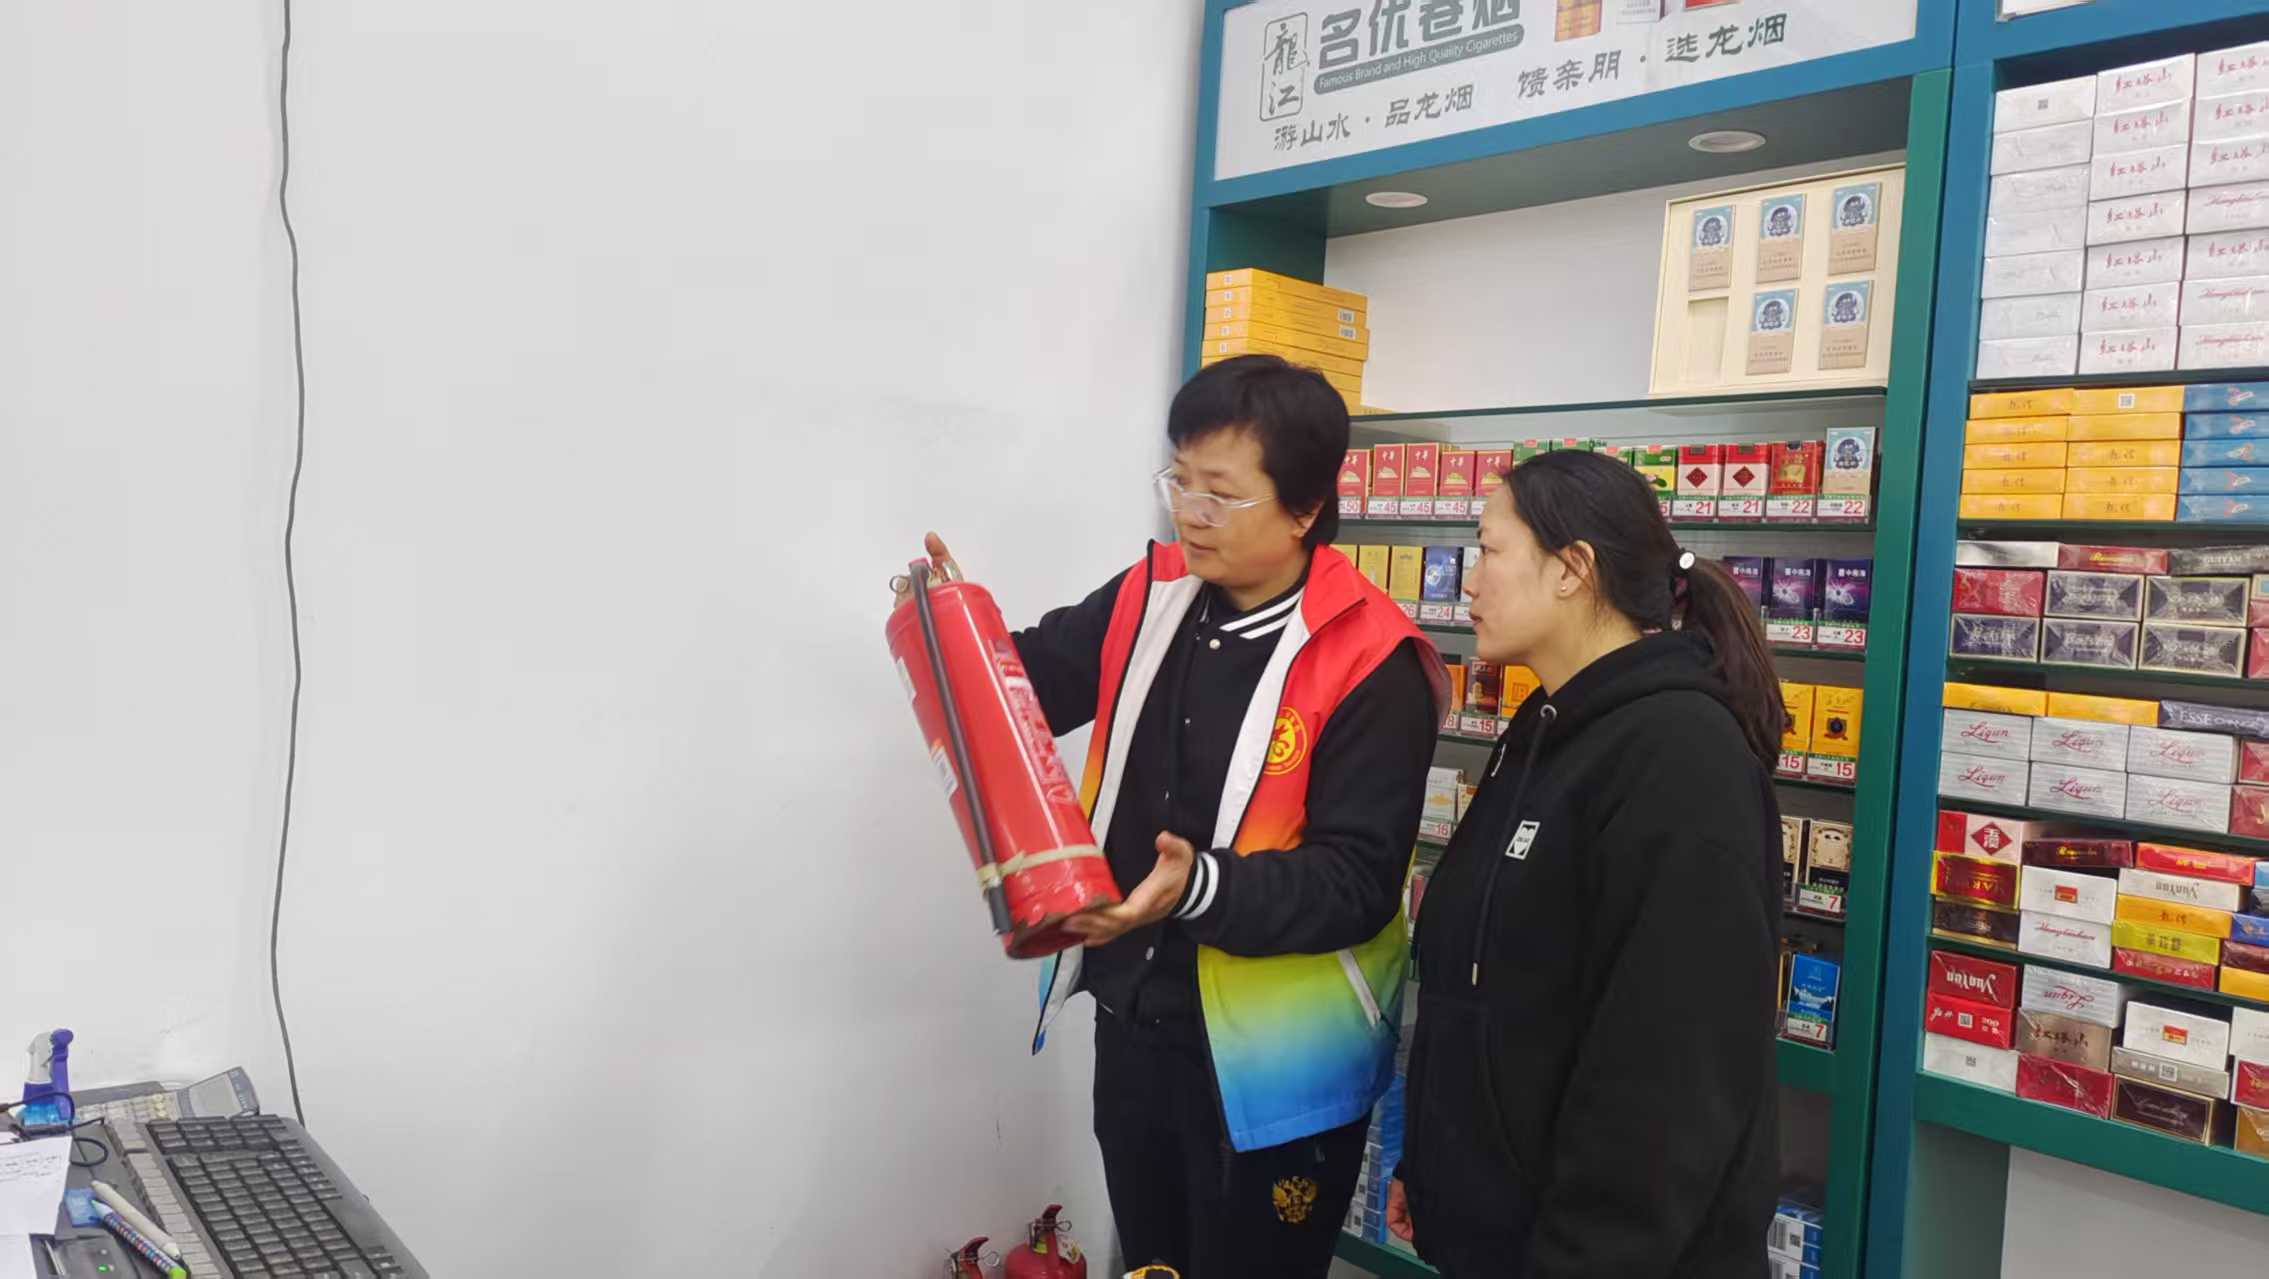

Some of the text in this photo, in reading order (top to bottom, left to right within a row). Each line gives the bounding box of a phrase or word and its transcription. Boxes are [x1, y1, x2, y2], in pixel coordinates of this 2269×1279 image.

[1318, 30, 1519, 89] Famous Brand and High Quality Cigarettes
[1695, 501, 1711, 515] 21
[1743, 500, 1760, 513] 21
[1792, 501, 1809, 513] 22
[1843, 501, 1863, 514] 22
[1792, 624, 1811, 640] 23
[1844, 629, 1864, 644] 23
[1480, 719, 1492, 732] 15
[1960, 721, 2009, 743] Liqun
[2052, 730, 2104, 752] Liqun
[1782, 755, 1800, 769] 15
[1836, 762, 1852, 777] 15
[1958, 766, 2006, 788] Liqun
[2050, 776, 2103, 799] Liqun
[1829, 896, 1838, 909] 7
[1815, 1024, 1824, 1038] 7
